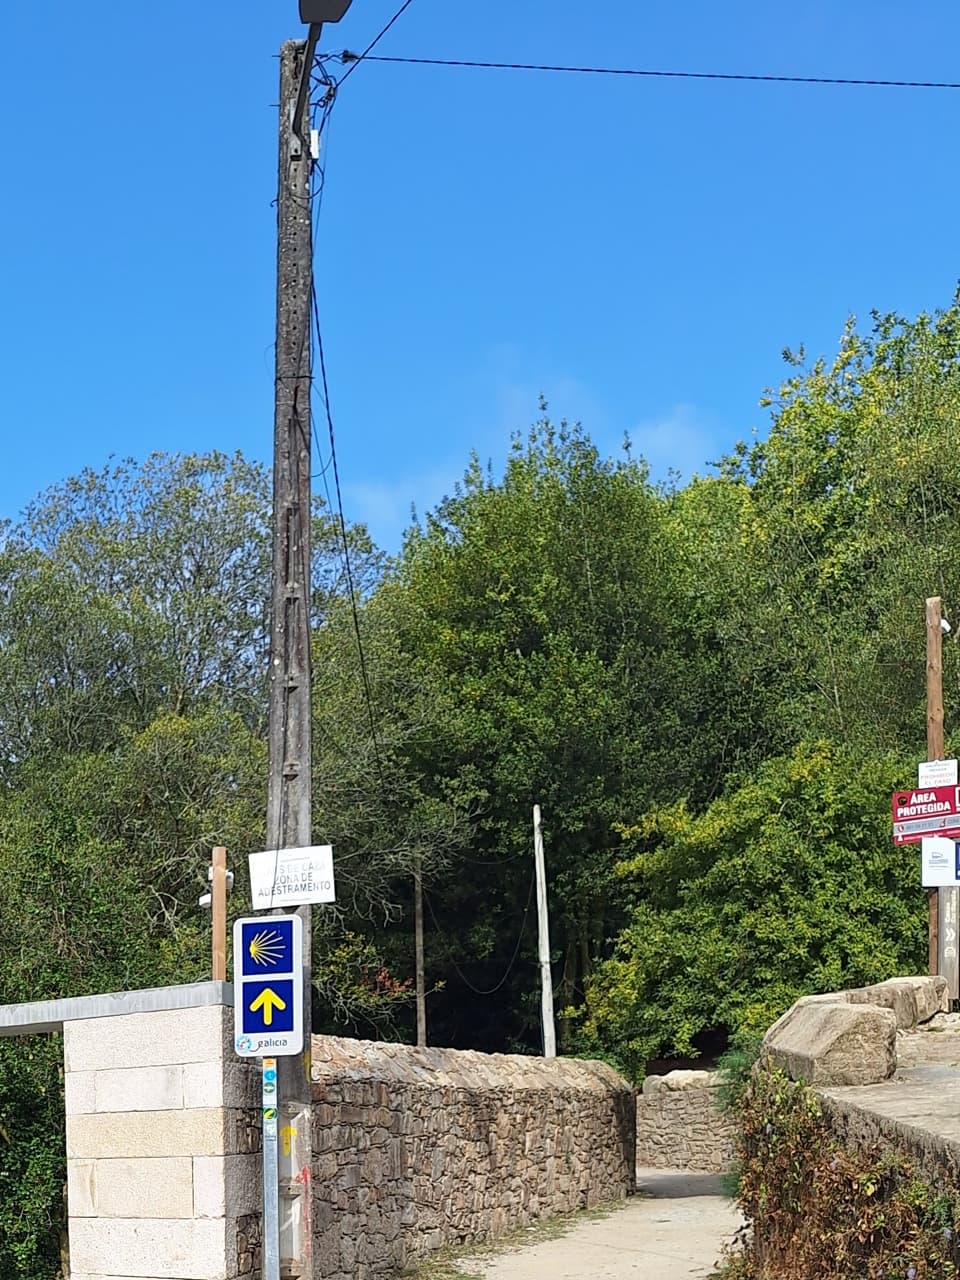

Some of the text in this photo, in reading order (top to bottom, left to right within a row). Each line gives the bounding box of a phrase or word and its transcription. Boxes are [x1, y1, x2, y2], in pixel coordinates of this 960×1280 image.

[910, 792, 936, 804] ÁREA
[897, 801, 951, 817] PROTEGIDA
[275, 871, 313, 886] ZONA DE
[258, 880, 331, 897] ADESTRAMENTO
[255, 1038, 288, 1050] galicia
